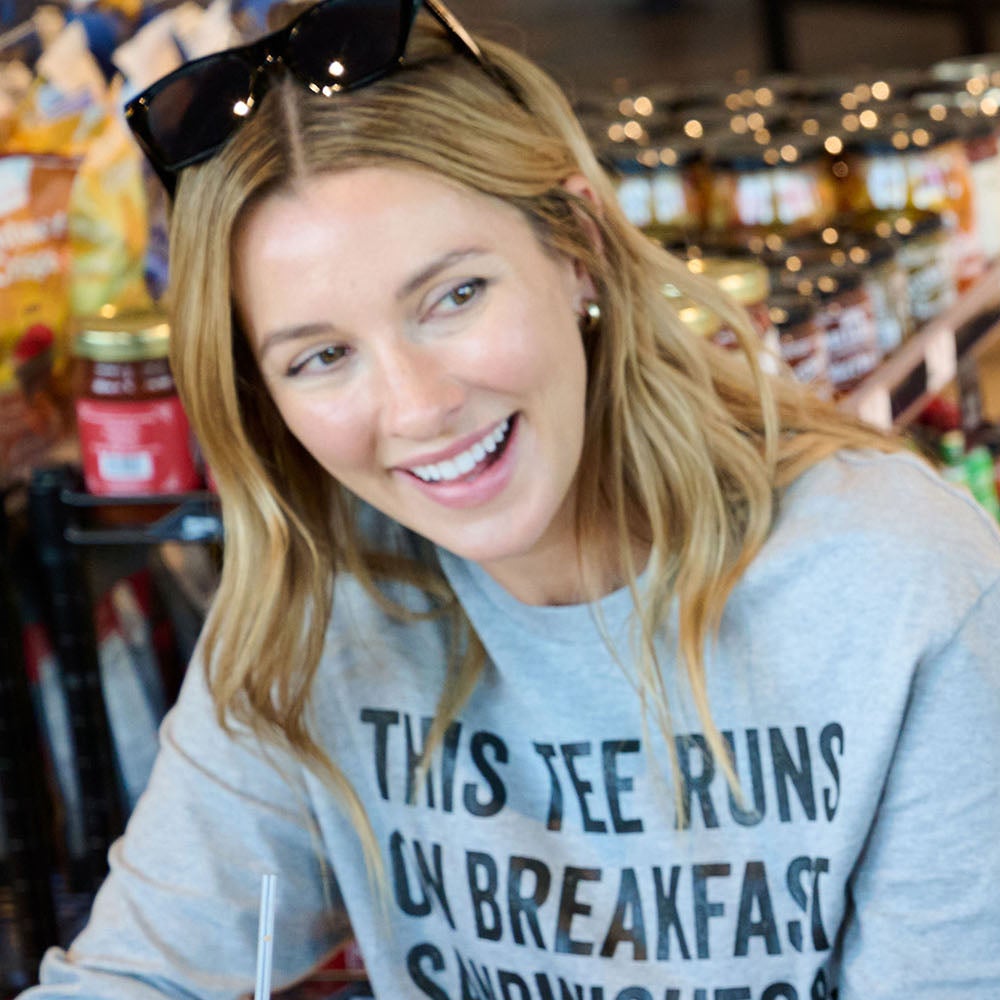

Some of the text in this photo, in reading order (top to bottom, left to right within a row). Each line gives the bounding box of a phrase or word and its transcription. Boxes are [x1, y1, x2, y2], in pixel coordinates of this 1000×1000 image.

[360, 707, 845, 834] THIS TEE RUNS
[466, 850, 831, 961] BREAKFAST
